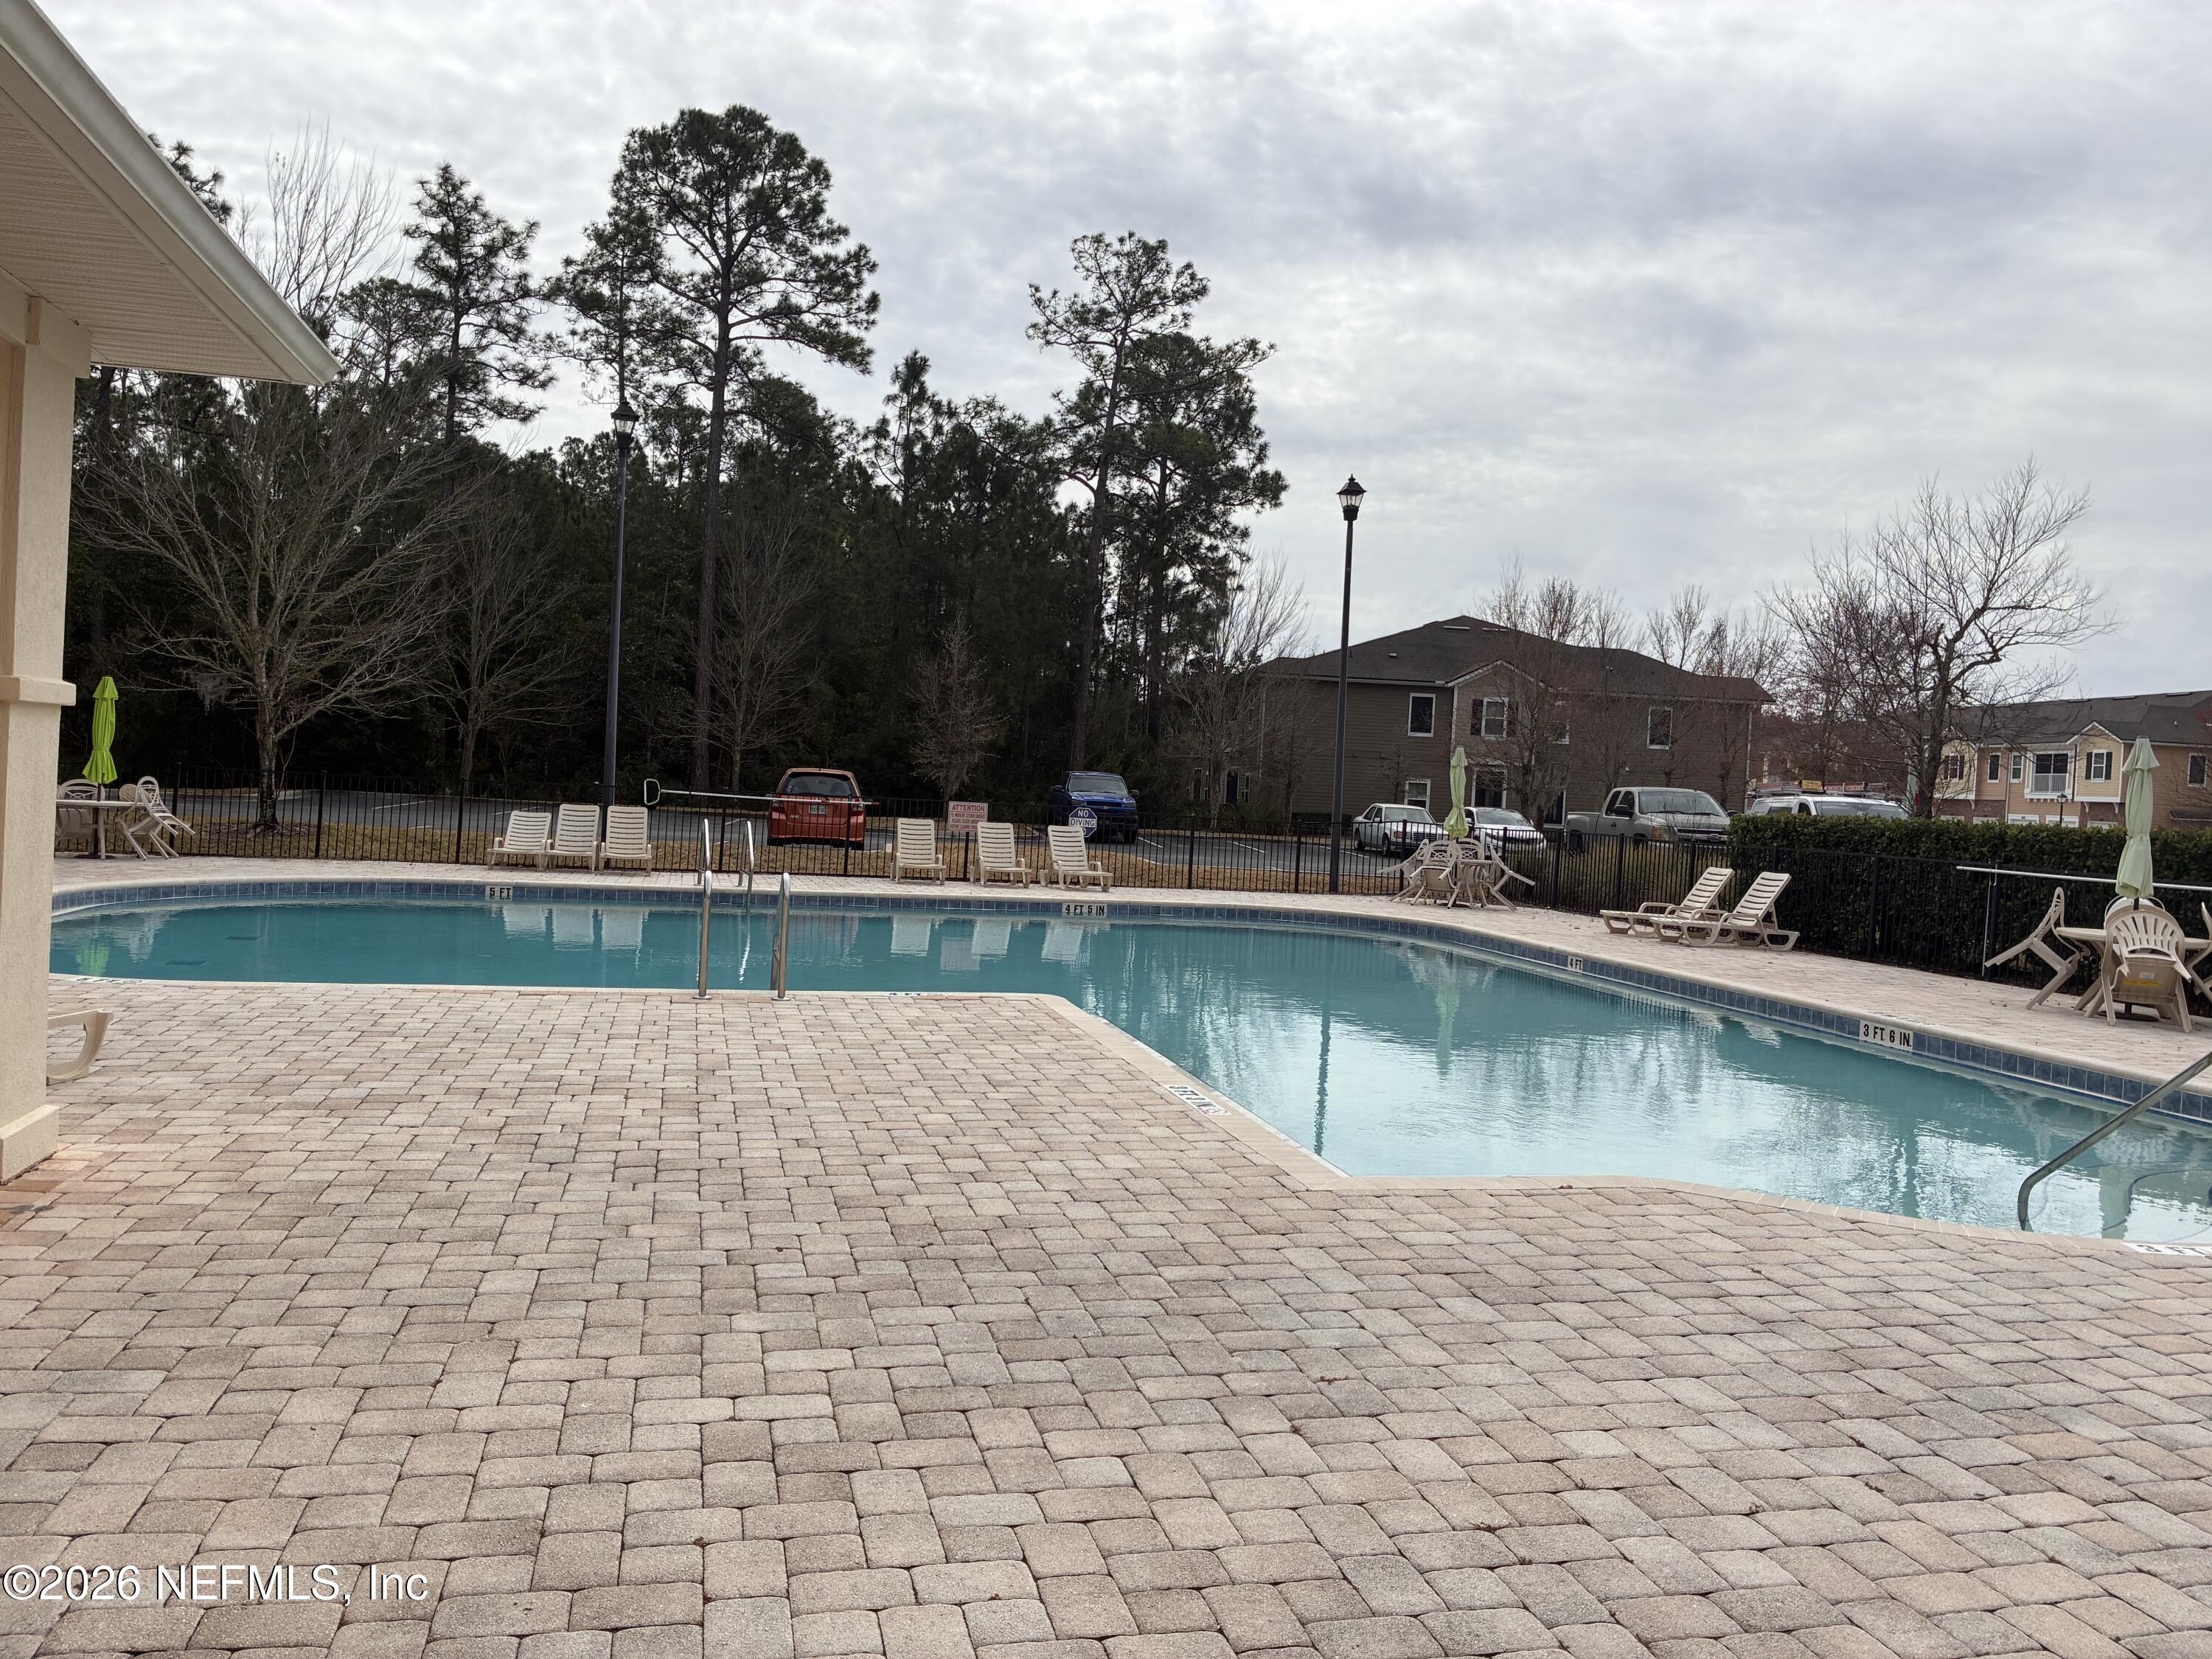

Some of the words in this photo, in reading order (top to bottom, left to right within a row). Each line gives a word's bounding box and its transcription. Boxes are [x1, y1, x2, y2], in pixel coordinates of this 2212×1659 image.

[1077, 810, 1089, 818] NO
[1071, 818, 1096, 827] DIVING
[489, 887, 495, 900] 5
[1065, 904, 1071, 915] 4
[1569, 958, 1573, 968] 4
[1863, 1023, 1870, 1037] 3
[1889, 1029, 1896, 1043] 6
[1899, 1032, 1912, 1047] IN.
